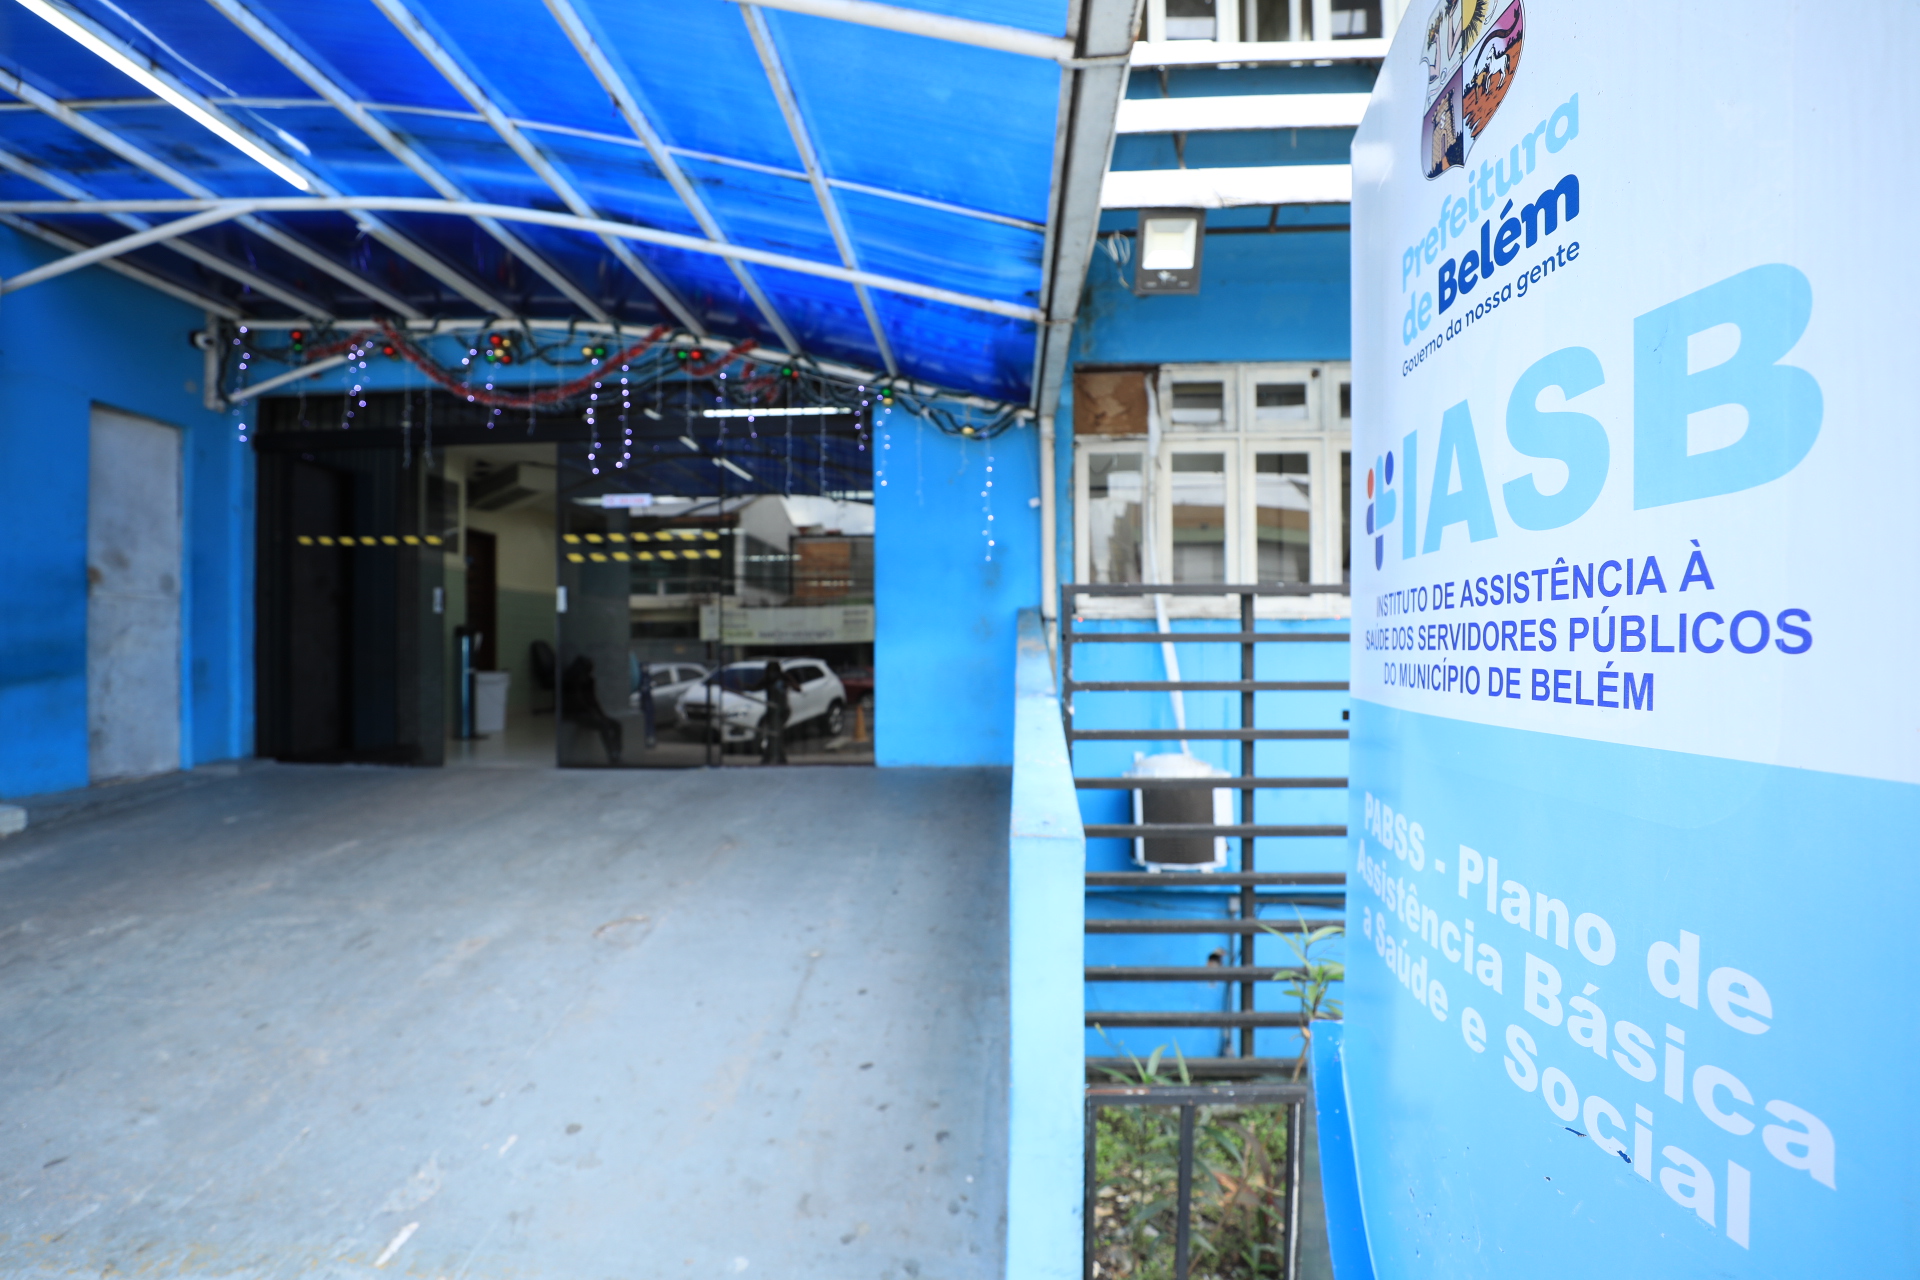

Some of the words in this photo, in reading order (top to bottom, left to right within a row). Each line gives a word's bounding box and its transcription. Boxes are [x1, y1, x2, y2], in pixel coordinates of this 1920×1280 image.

[1402, 93, 1579, 292] Prefeitura
[1403, 286, 1432, 345] de
[1438, 173, 1579, 314] Belém
[1402, 332, 1443, 377] Governo
[1445, 313, 1462, 341] da
[1465, 286, 1512, 330] nossa
[1517, 241, 1580, 299] gente
[1402, 263, 1825, 560] IASB
[1365, 621, 1389, 652] SAÚDE
[1391, 625, 1415, 651] DOS
[1417, 618, 1557, 653] SERVIDORES
[1569, 606, 1813, 654] PÚBLICOS
[1376, 586, 1427, 618] INSTITUTO
[1432, 582, 1455, 612] DE
[1460, 557, 1667, 608] ASSISTÊNCIA
[1679, 539, 1715, 592] À
[1384, 661, 1396, 686] DO
[1399, 657, 1480, 693] MUNICÍPIO
[1488, 667, 1521, 700] DE
[1531, 661, 1654, 711] BELÉM
[1365, 791, 1425, 872] PABSS
[1458, 844, 1616, 966] Plano
[1647, 929, 1773, 1035] de
[1357, 839, 1502, 994] Assistência
[1524, 951, 1837, 1191] Básica
[1362, 905, 1372, 940] a
[1375, 915, 1448, 1022] Saúde
[1461, 1006, 1486, 1054] e
[1504, 1024, 1750, 1250] Social
